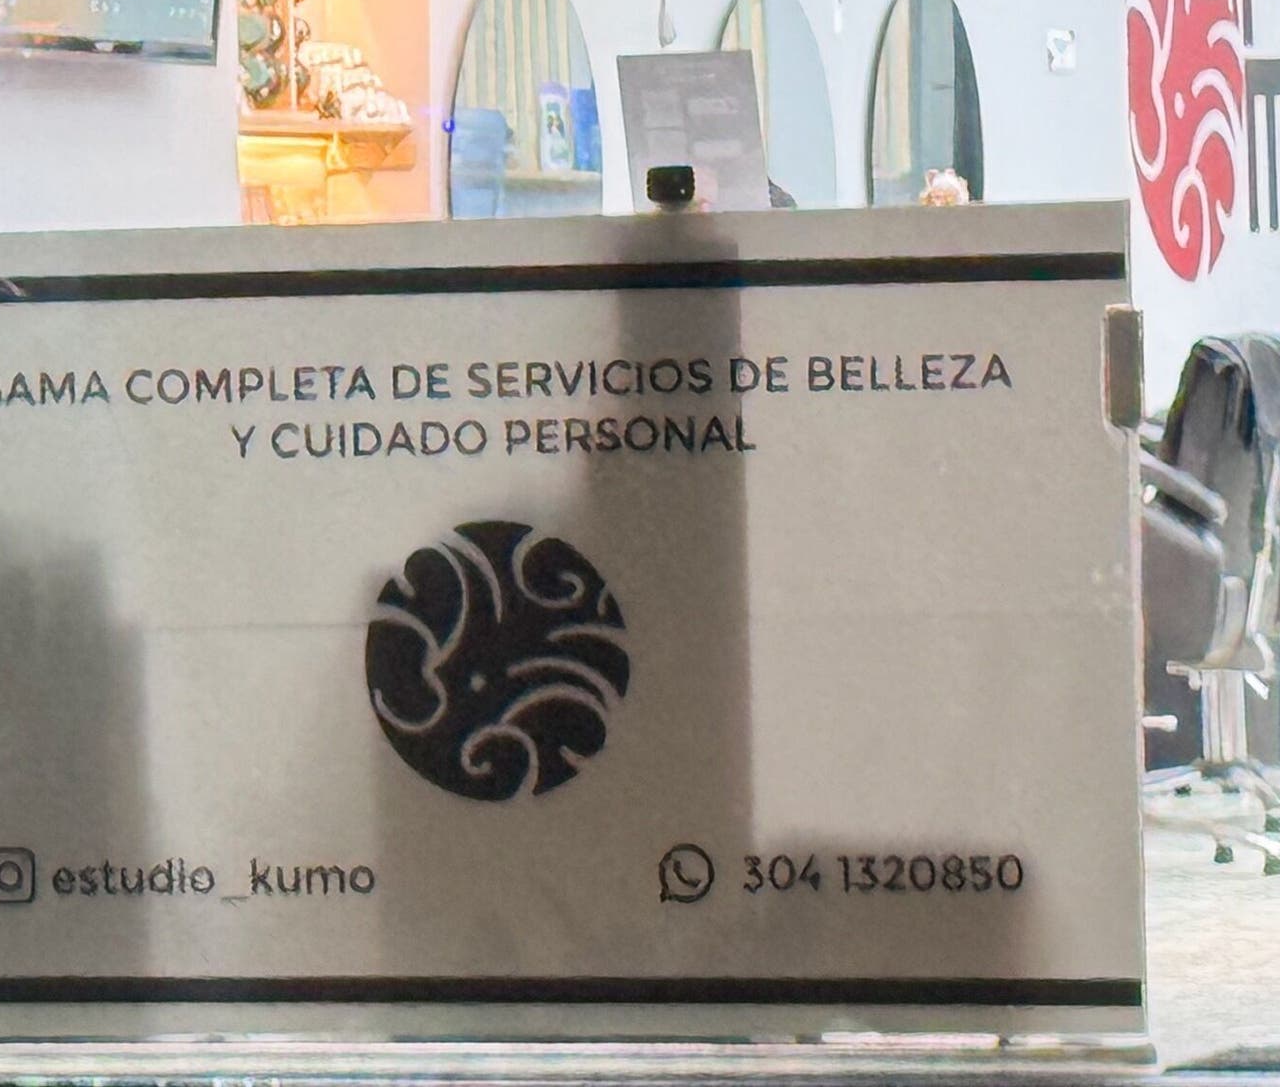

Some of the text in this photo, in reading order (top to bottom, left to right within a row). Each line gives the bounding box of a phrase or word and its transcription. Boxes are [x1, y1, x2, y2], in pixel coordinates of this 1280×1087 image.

[125, 364, 376, 405] COMPLETA
[391, 362, 450, 400] DE
[467, 358, 713, 399] SERVICIOS
[729, 356, 789, 393] DE
[807, 353, 1013, 391] BELLEZA
[231, 415, 757, 460] Y CUIDADO PERSONAL
[742, 853, 1024, 894] 304 1320850
